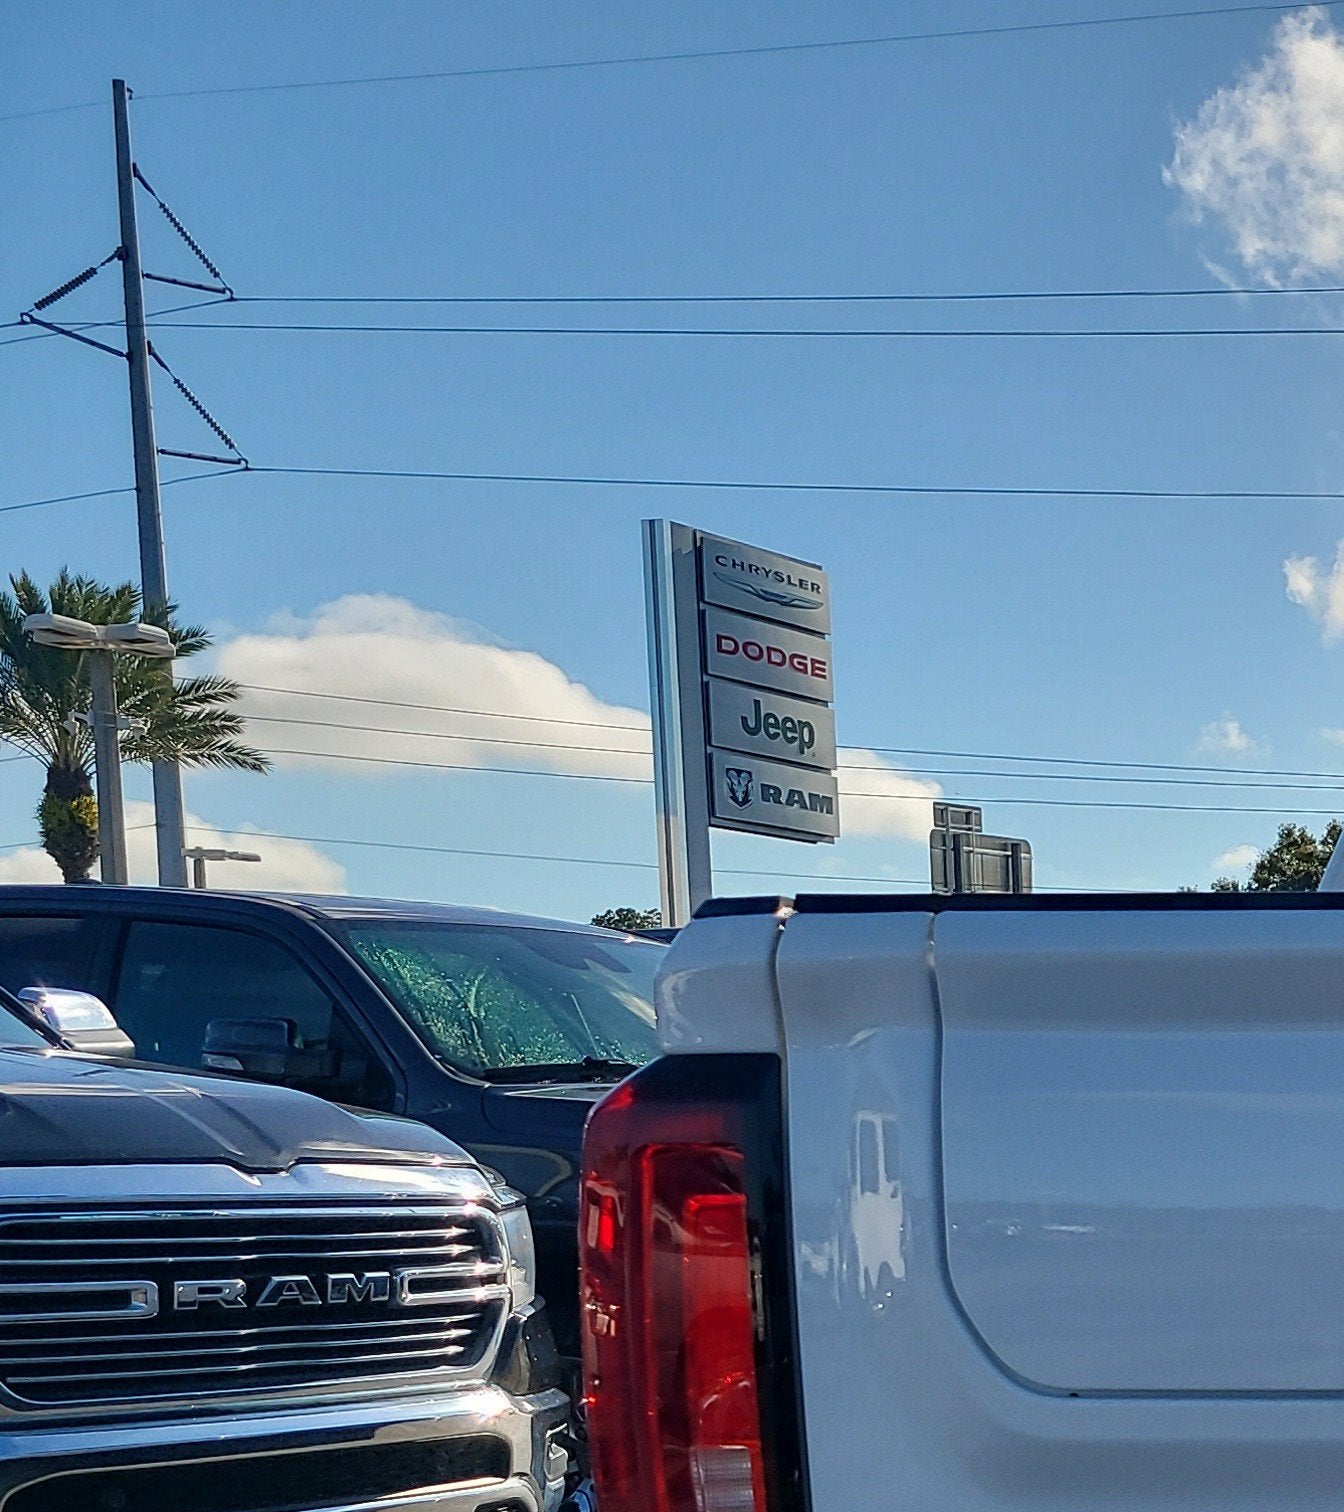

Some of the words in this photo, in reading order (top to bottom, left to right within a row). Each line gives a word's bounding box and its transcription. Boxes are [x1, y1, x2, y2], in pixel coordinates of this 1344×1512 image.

[715, 555, 821, 594] CHRYSLER
[716, 633, 827, 680] DODGE
[741, 699, 815, 755] Jeep
[760, 782, 834, 815] RAM
[173, 1271, 390, 1310] RAM
